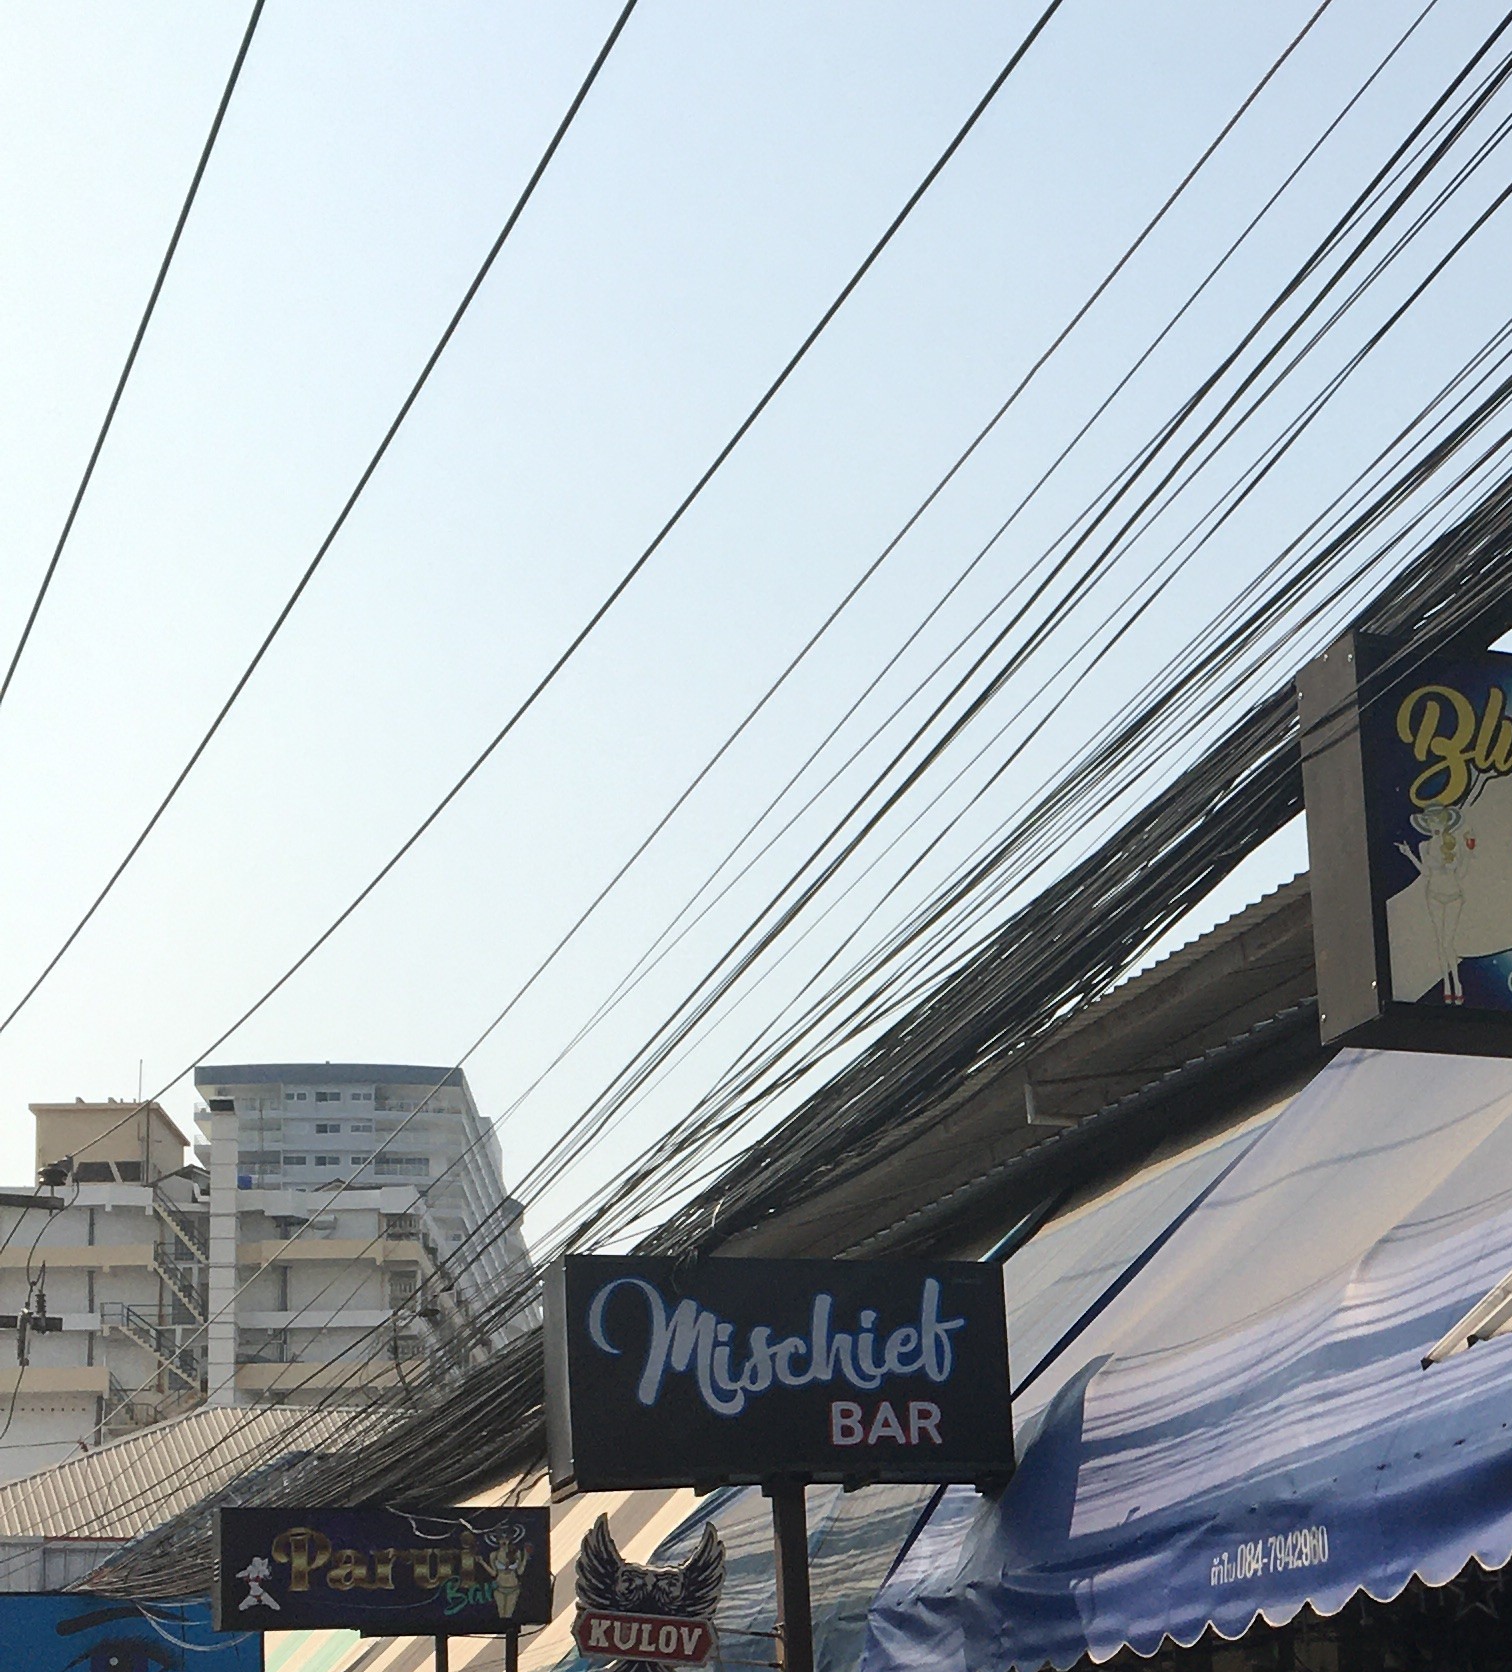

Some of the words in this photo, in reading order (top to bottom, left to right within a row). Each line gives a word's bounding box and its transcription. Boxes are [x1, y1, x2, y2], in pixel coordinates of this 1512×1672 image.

[588, 1278, 964, 1416] Mischief
[829, 1401, 943, 1445] BAR
[443, 1575, 498, 1616] Bar
[588, 1617, 702, 1656] KULOV
